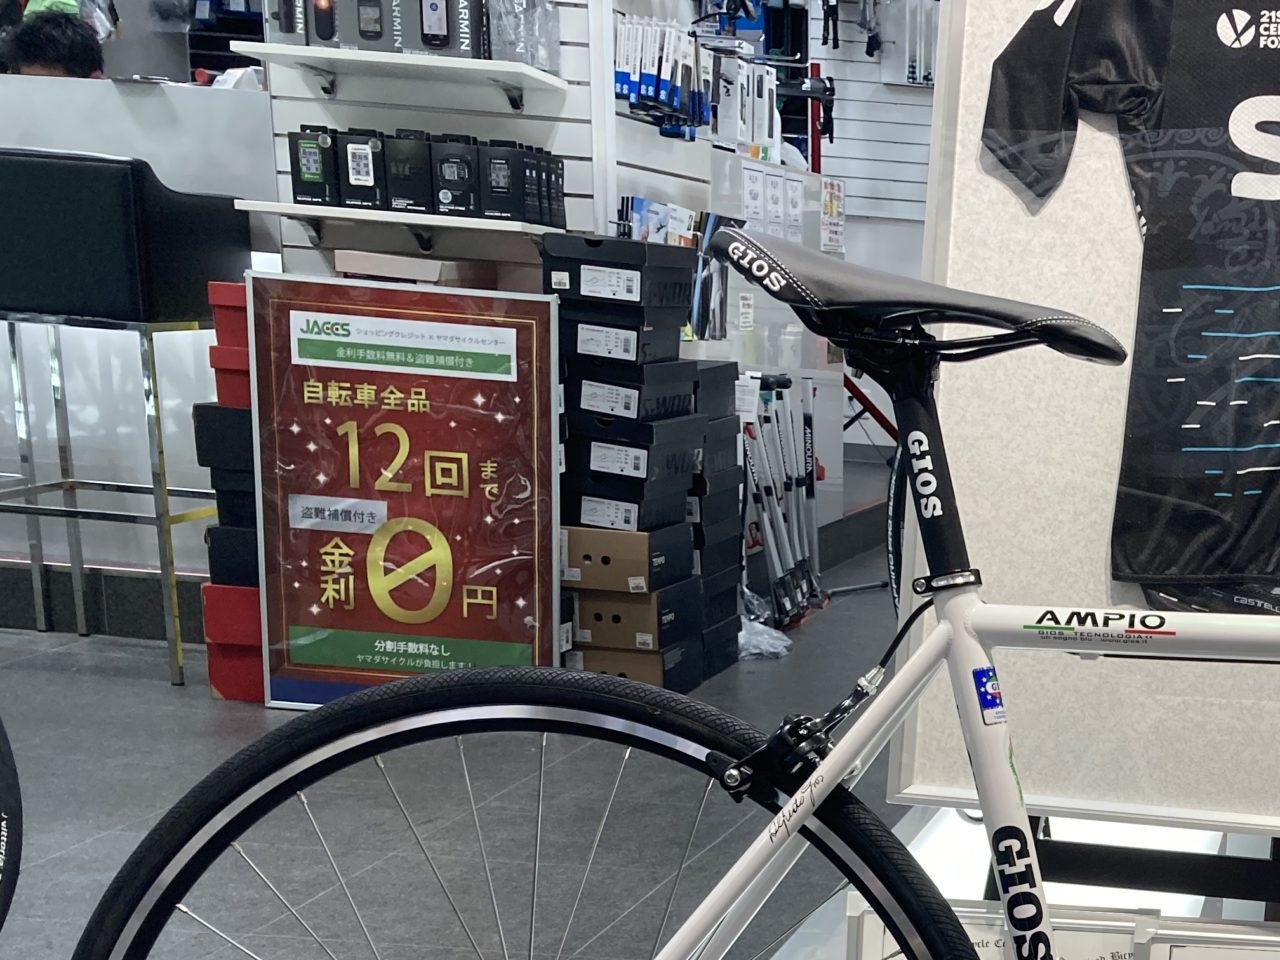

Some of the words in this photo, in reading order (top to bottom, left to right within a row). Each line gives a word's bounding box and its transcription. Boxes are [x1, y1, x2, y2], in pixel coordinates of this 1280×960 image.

[392, 0, 403, 47] ARMIN
[459, 0, 470, 50] ARMIN
[728, 241, 786, 292] GIOS
[300, 319, 351, 337] JACCS
[303, 379, 430, 413] 自転車全品
[803, 425, 813, 473] MINOURA
[908, 430, 943, 519] GIOS
[301, 506, 377, 523] 盗難補償付き
[319, 537, 355, 610] 金利
[1035, 610, 1166, 630] AMPIO
[1073, 631, 1142, 640] TECNOLOGIA
[374, 640, 451, 656] 分割手数料なし
